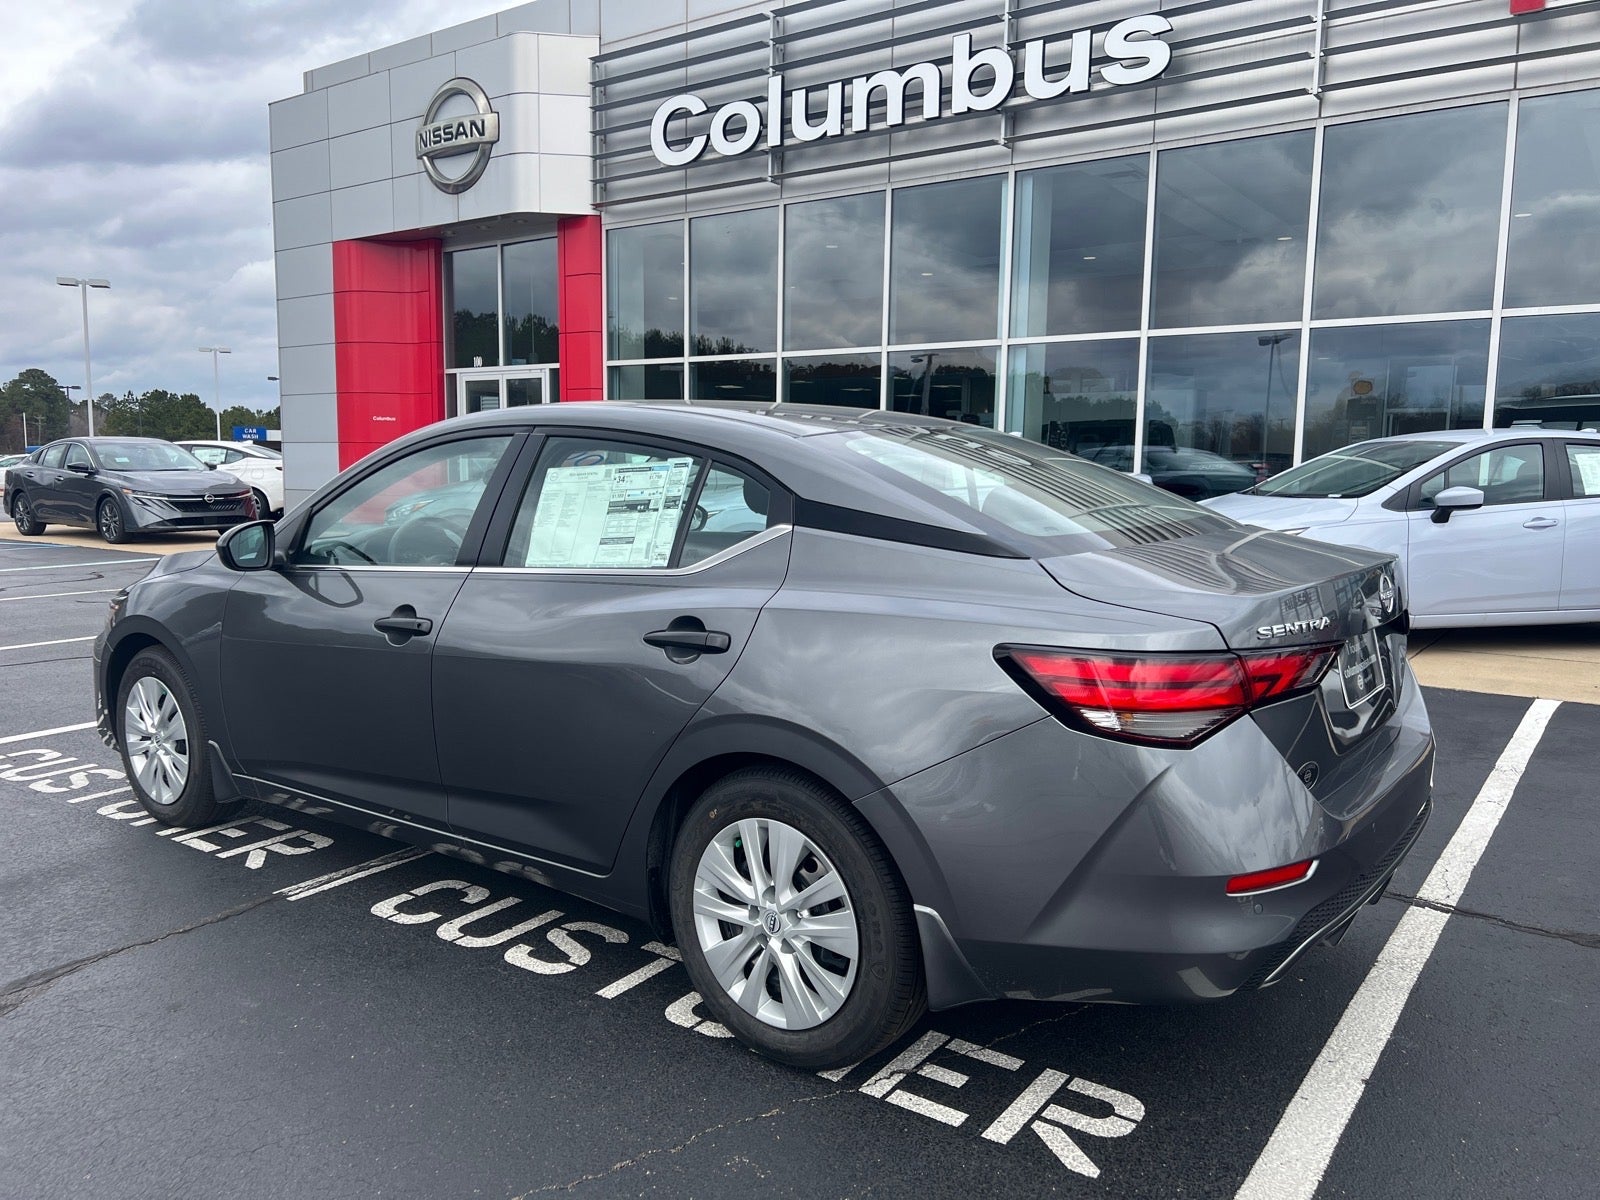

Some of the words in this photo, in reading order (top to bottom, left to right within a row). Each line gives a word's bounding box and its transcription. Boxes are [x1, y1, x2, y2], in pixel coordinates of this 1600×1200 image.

[418, 118, 486, 149] NISSAN
[649, 13, 1174, 166] Columbus
[1256, 616, 1331, 640] SENTRA
[370, 879, 1146, 1179] CUSTER
